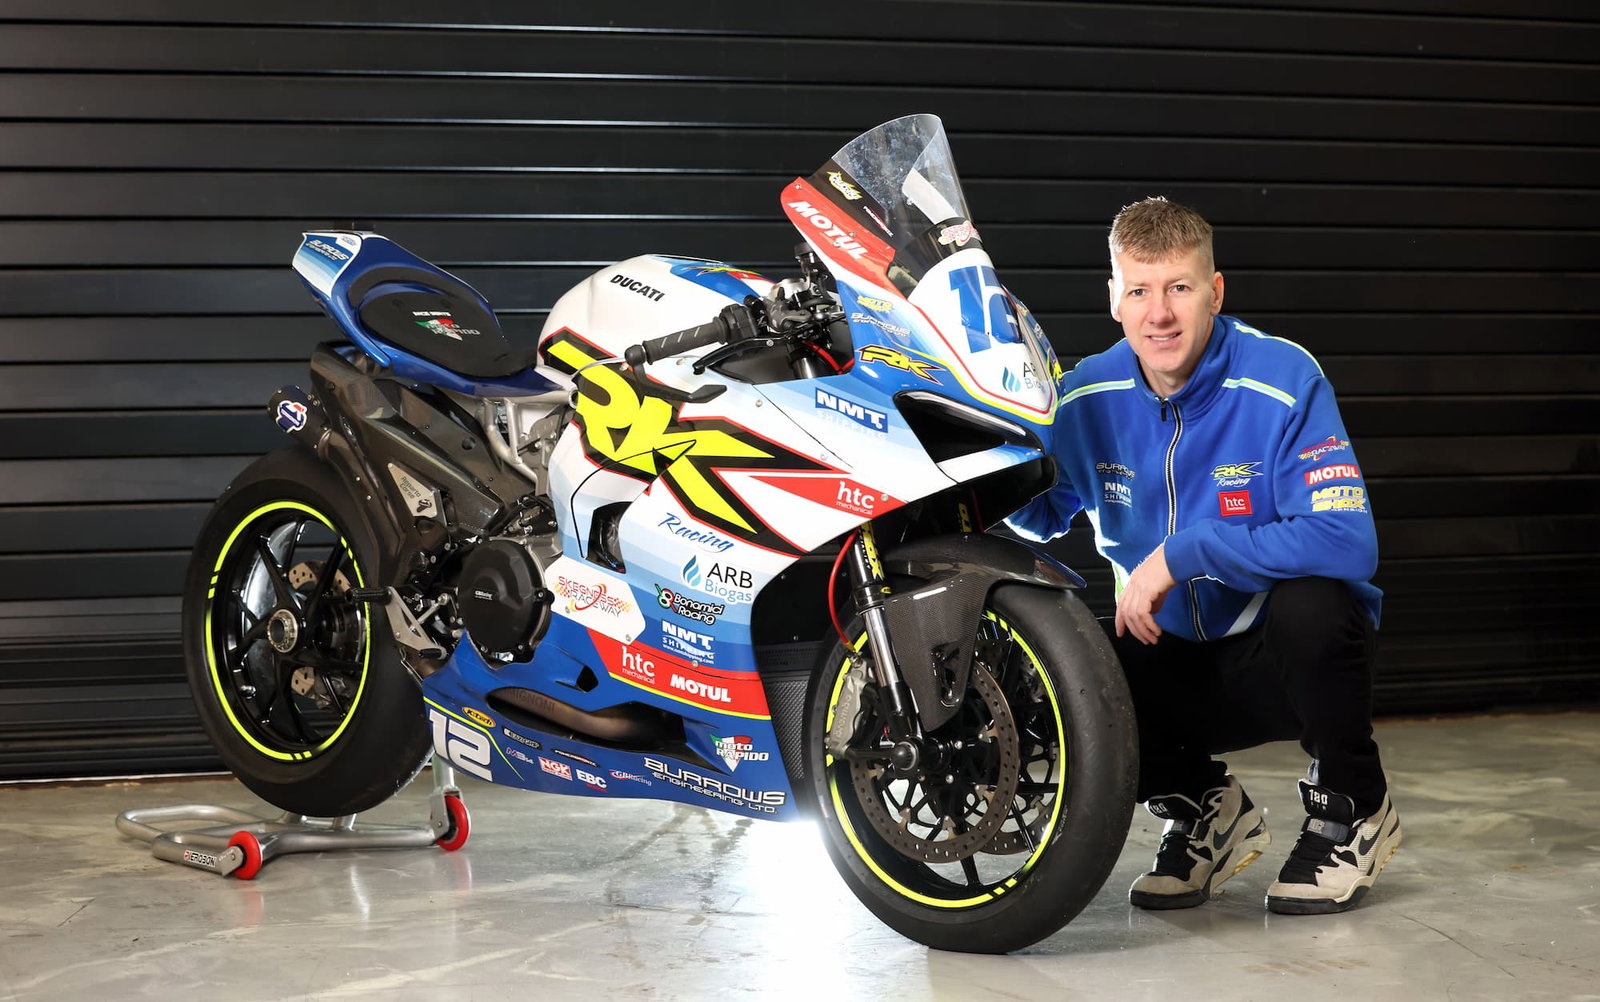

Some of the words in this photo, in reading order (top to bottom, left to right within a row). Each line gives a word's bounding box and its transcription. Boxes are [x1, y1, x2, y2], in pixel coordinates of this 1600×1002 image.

[788, 201, 868, 260] MOTUL
[610, 274, 666, 302] DUCATI
[948, 265, 1023, 354] 12
[857, 345, 943, 385] RK
[816, 389, 887, 430] NMT
[545, 335, 788, 538] RK
[1211, 461, 1264, 480] RK
[1216, 478, 1251, 488] Racing
[1309, 465, 1359, 485] MOTUL
[837, 480, 875, 509] htc
[1223, 496, 1246, 508] htc
[1312, 486, 1364, 501] MOTO
[836, 501, 873, 516] mechanical
[657, 512, 735, 553] Racing
[706, 562, 753, 589] ARB
[558, 575, 617, 607] SKEGNESS
[570, 588, 622, 617] RACEWAY
[674, 593, 725, 615] Bonamici
[704, 578, 752, 604] Biogas
[678, 605, 716, 625] Racing
[662, 620, 714, 650] NMT
[621, 645, 656, 677] htc
[622, 667, 656, 684] mechanical
[669, 673, 732, 703] MOTUL
[428, 708, 494, 782] 12
[714, 740, 753, 751] moto
[716, 749, 770, 762] RAPIDO
[540, 760, 570, 776] NGK
[576, 768, 608, 789] EBC
[643, 756, 787, 805] BURROWS
[652, 771, 745, 806] ENGINEERING
